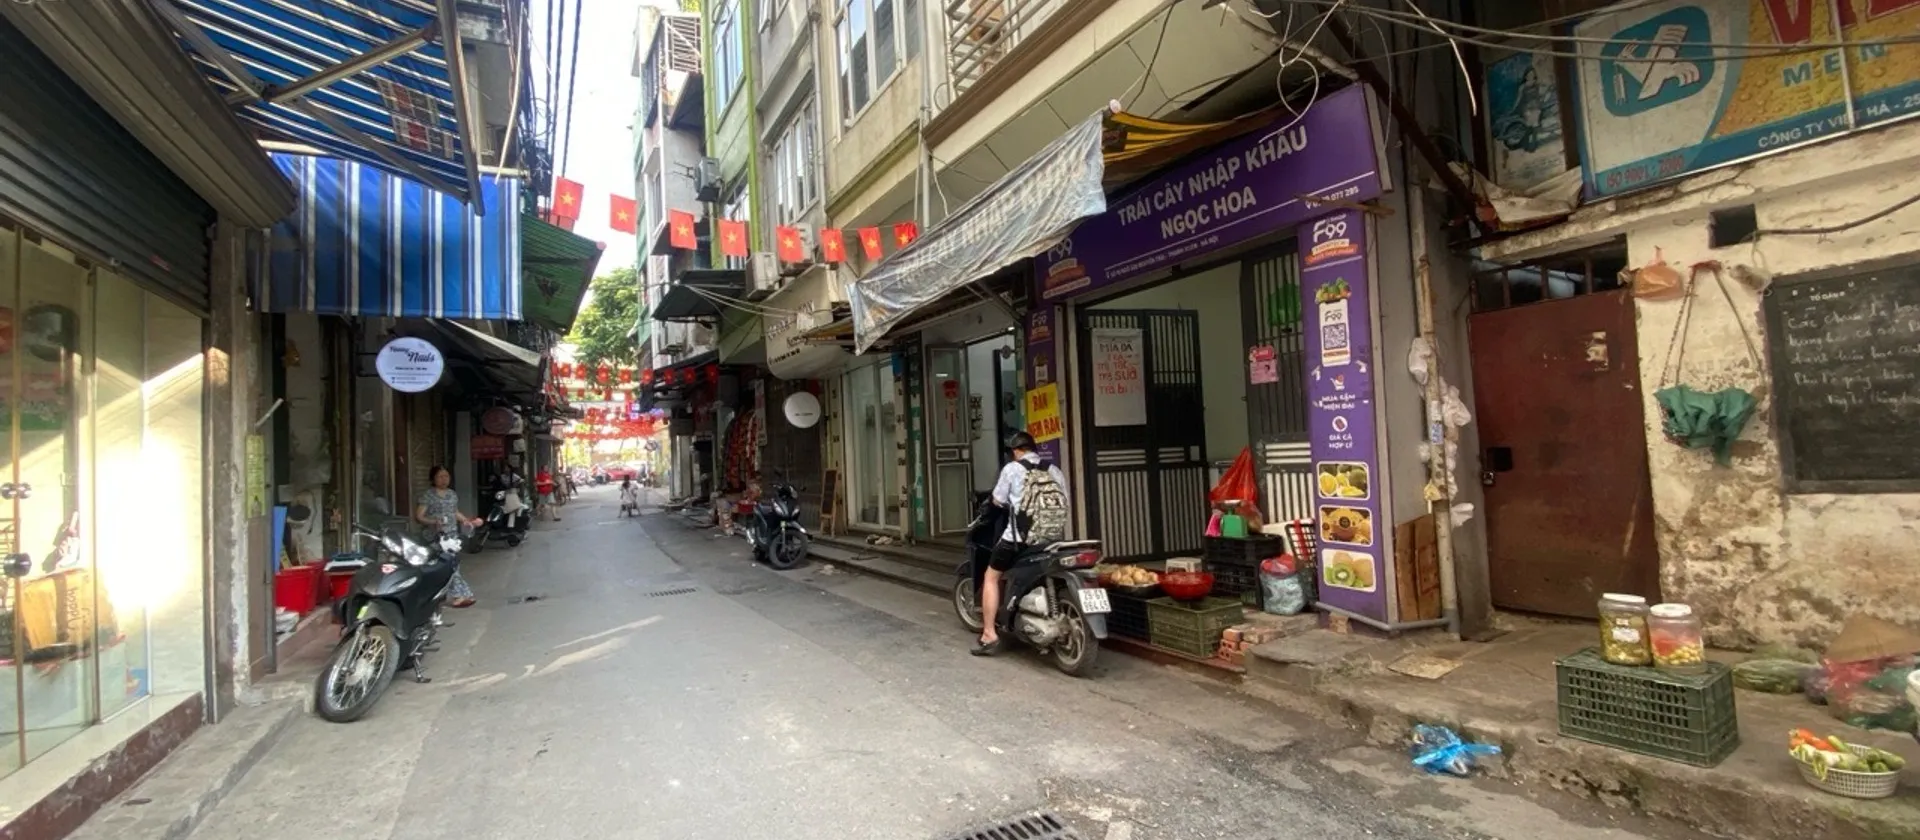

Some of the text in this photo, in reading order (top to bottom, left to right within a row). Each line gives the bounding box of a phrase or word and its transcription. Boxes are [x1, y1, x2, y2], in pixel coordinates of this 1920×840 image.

[1758, 129, 1802, 149] CÔNG
[1805, 121, 1825, 135] TY
[1117, 193, 1150, 226] TRÁI
[1154, 181, 1184, 211] CÂY
[1188, 157, 1241, 197] NHẬP
[1160, 186, 1257, 239] NGỌC HOA
[1313, 220, 1347, 243] F99
